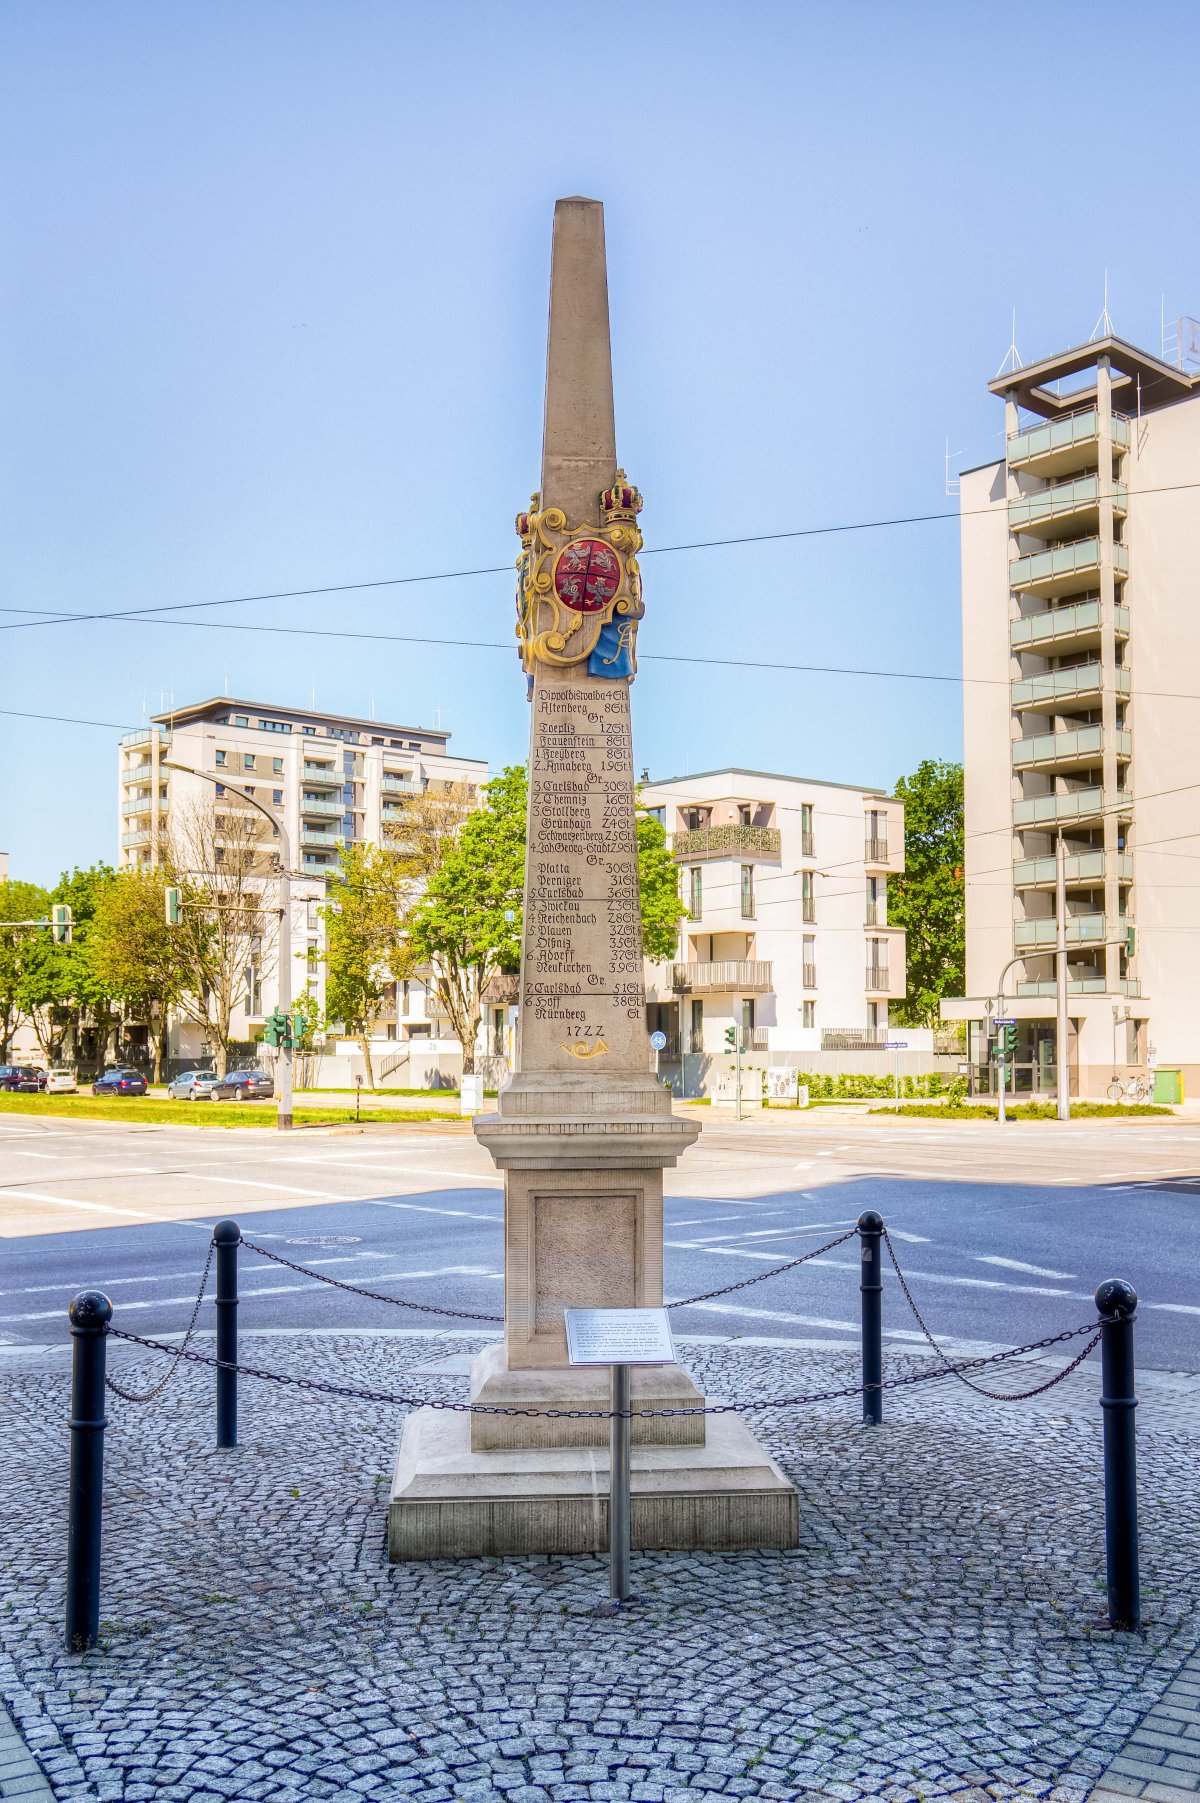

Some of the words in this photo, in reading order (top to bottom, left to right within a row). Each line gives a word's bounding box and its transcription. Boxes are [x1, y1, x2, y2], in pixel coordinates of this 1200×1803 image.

[538, 702, 588, 715] Altenberg
[540, 735, 595, 748] Frauenstein
[537, 862, 570, 875] Platta
[536, 961, 592, 975] Neukirchen
[535, 1008, 586, 1021] Nürnberg
